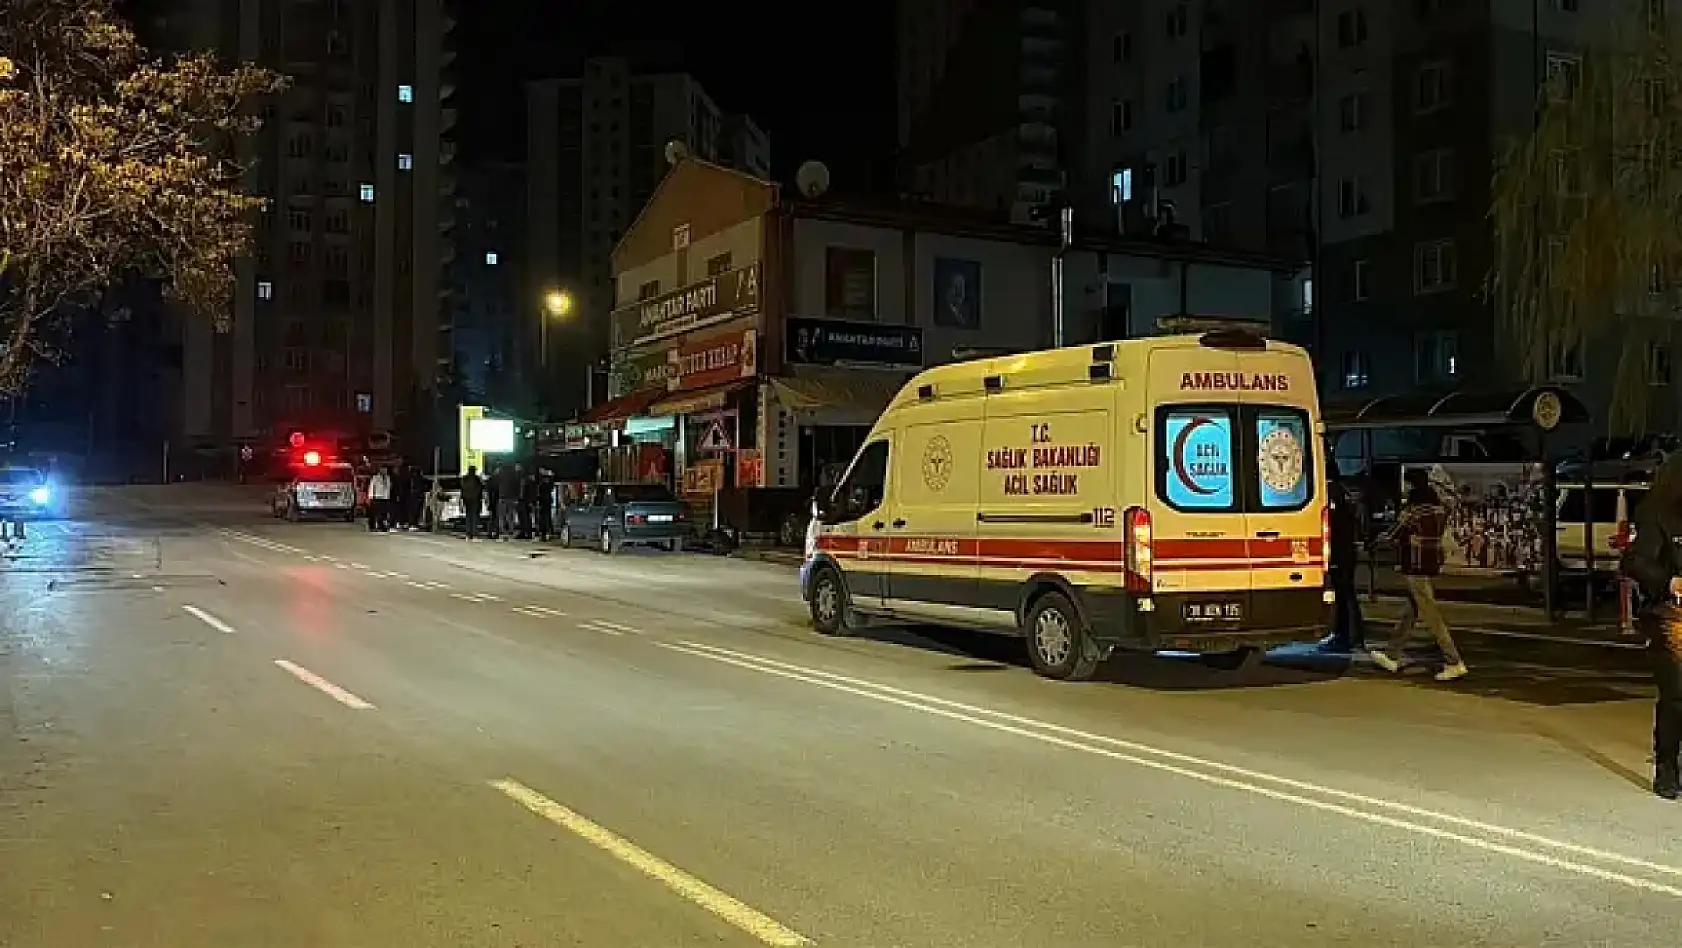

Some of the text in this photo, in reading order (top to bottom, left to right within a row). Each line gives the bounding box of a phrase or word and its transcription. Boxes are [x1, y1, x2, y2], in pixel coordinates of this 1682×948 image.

[1180, 372, 1290, 391] AMBULANS
[987, 442, 1101, 470] SAĞLIK BAKANLIĞI
[1004, 470, 1078, 496] ACİL SAĞLIK
[1093, 508, 1115, 528] 112
